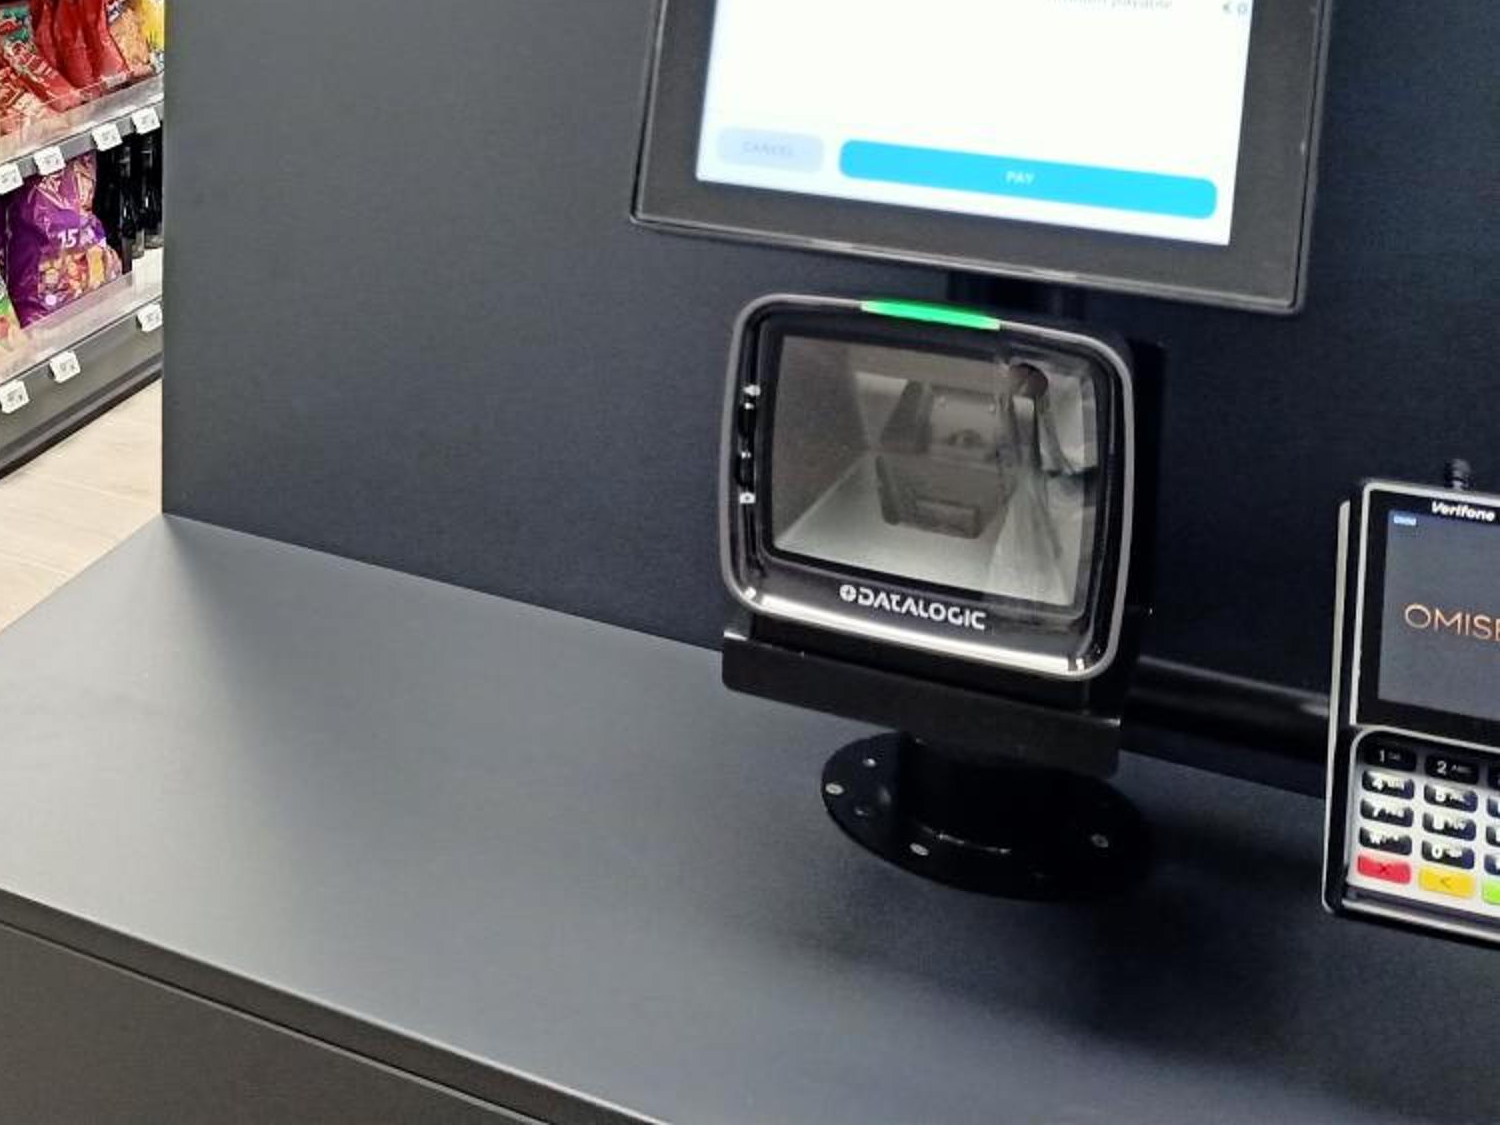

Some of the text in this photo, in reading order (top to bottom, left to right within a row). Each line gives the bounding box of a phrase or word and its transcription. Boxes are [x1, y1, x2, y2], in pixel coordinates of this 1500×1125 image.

[1005, 170, 1036, 185] PAY
[1431, 500, 1496, 522] Verifone
[857, 586, 987, 631] DATALOGIC
[1436, 760, 1447, 775] 2
